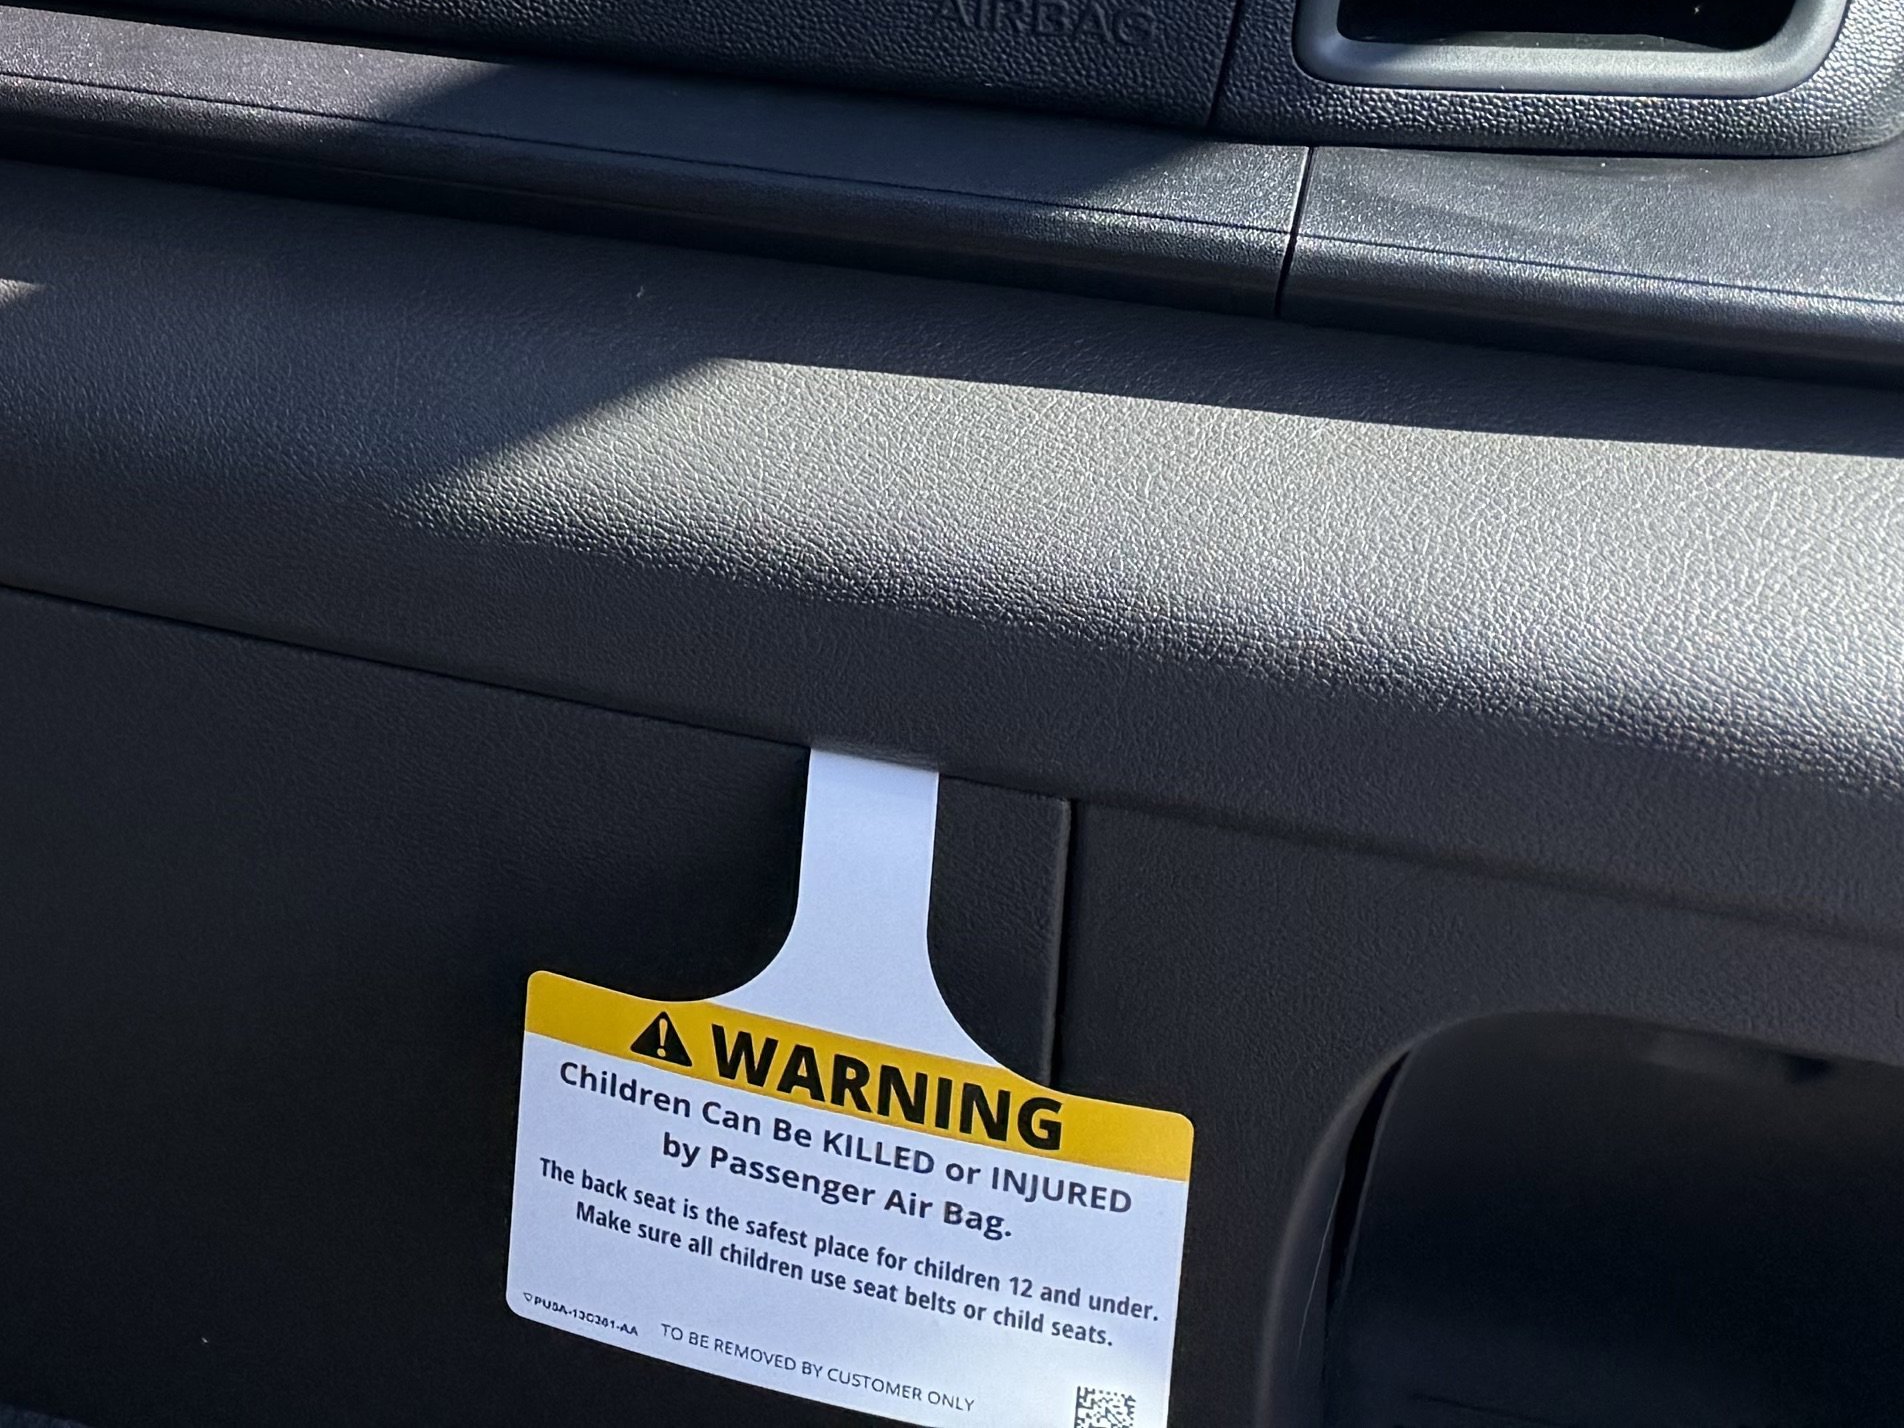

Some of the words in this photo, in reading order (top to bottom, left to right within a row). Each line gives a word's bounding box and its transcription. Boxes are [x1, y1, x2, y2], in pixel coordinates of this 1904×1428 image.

[560, 1061, 691, 1118] Children
[702, 1101, 761, 1136] Can
[772, 1118, 813, 1147] Be
[822, 1129, 935, 1175] KILLED
[945, 1161, 981, 1186] or
[992, 1166, 1132, 1214] INJURED
[711, 1023, 1064, 1151] WARNING
[540, 1157, 575, 1185] The
[581, 1169, 628, 1201] back
[633, 1188, 676, 1215] seat
[682, 1199, 699, 1220] is
[705, 1206, 740, 1231] the
[746, 1218, 808, 1249] safest
[814, 1235, 870, 1263] place
[877, 1246, 907, 1272] for
[914, 1256, 1000, 1292] children
[1008, 1275, 1034, 1298] 12
[1041, 1285, 1081, 1308] and
[1088, 1293, 1159, 1321] under.
[663, 1132, 700, 1168] by
[710, 1146, 876, 1207] Passenger
[884, 1189, 933, 1219] Air
[943, 1201, 1012, 1241] Bag.
[576, 1201, 632, 1234] Make
[638, 1223, 682, 1248] sure
[688, 1235, 713, 1257] all
[719, 1243, 803, 1281] children
[811, 1267, 846, 1291] use
[853, 1277, 898, 1303] seat
[904, 1285, 956, 1315] belts
[963, 1300, 987, 1321] or
[993, 1306, 1043, 1333] child
[1051, 1319, 1113, 1347] seats.
[661, 1323, 684, 1340] TO
[689, 1331, 709, 1349] BE
[714, 1338, 797, 1371] REMOVED
[802, 1361, 823, 1378] BY
[828, 1368, 922, 1401] CUSTOMER
[928, 1391, 975, 1413] ONLY
